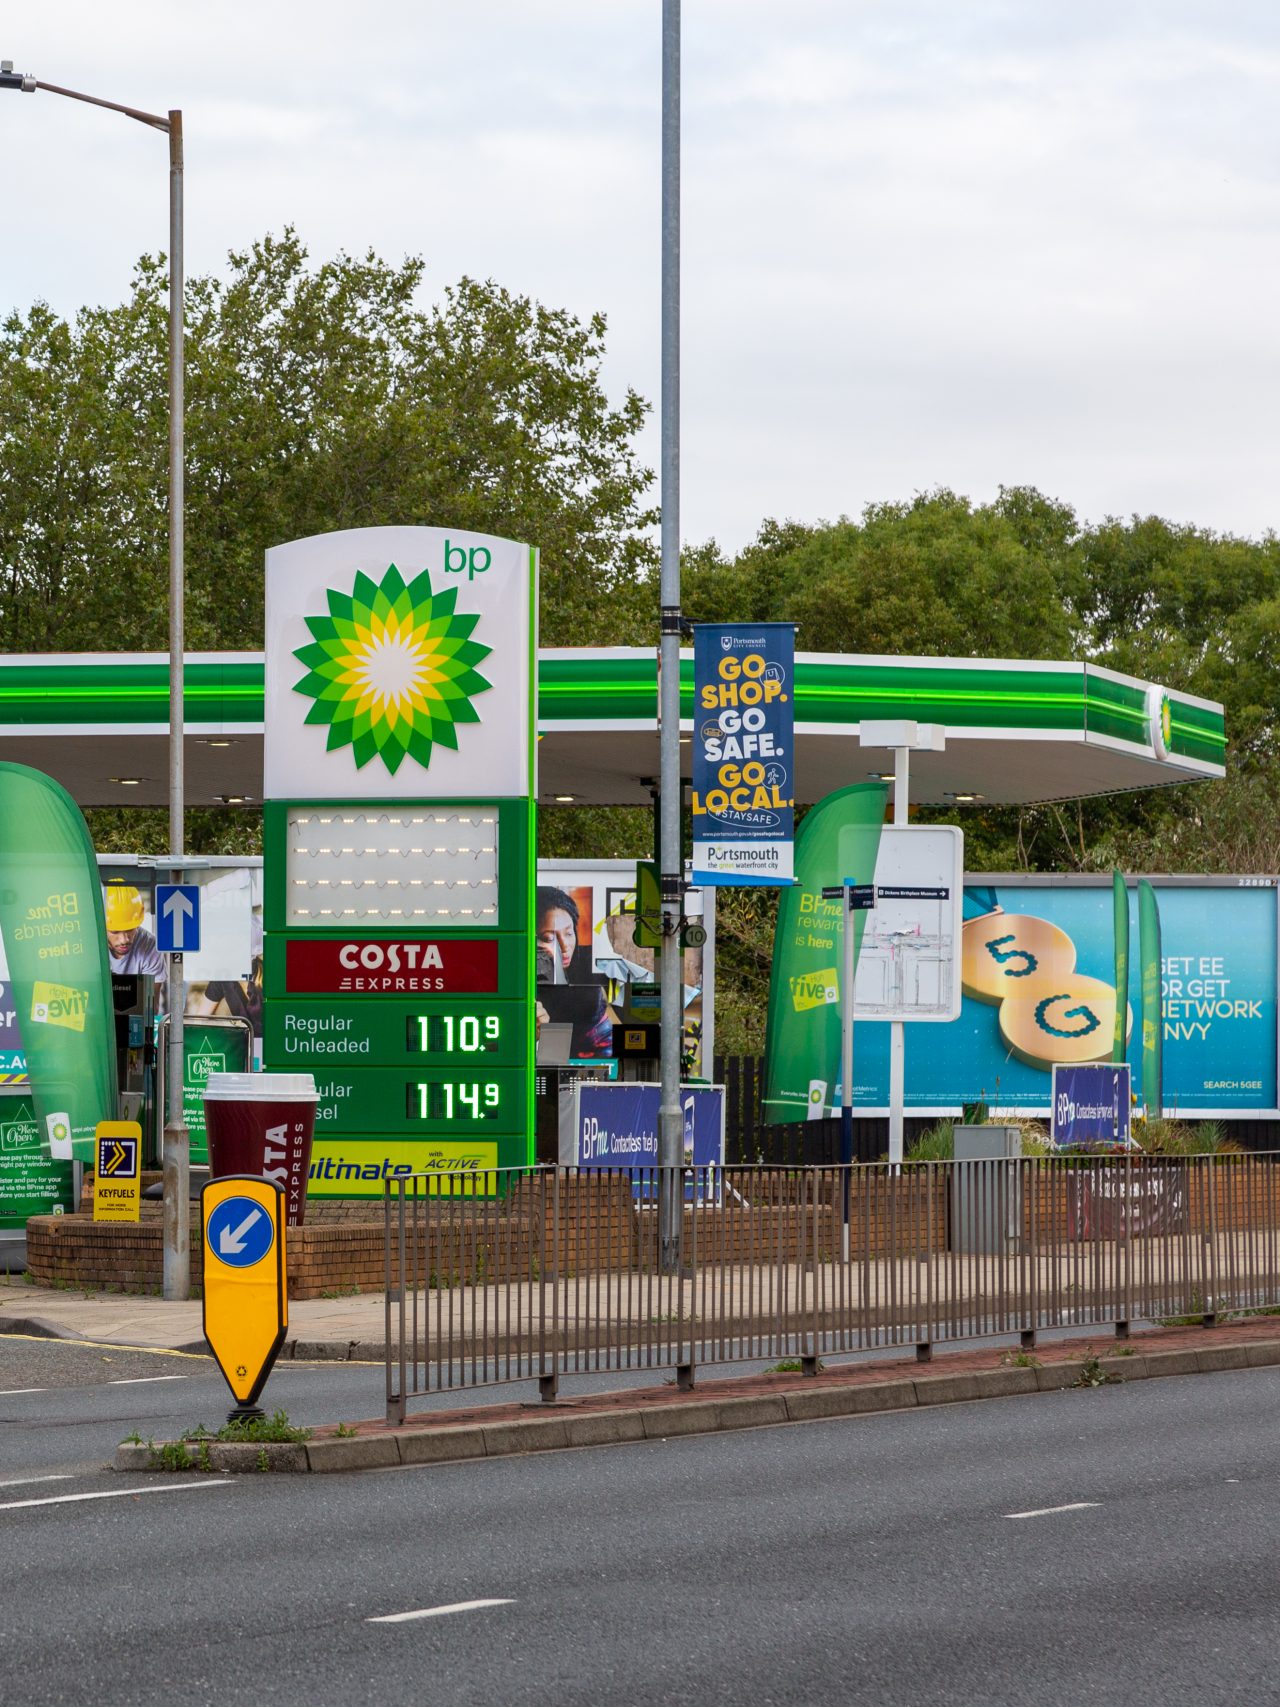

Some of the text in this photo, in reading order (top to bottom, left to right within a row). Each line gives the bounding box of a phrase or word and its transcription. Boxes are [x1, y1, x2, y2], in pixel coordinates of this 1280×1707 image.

[443, 540, 492, 580] bp
[733, 637, 767, 645] Portsmouth
[718, 654, 766, 681] GO
[701, 680, 788, 709] SHOP.
[718, 707, 766, 734] GO
[704, 733, 784, 762] SAFE.
[718, 761, 766, 788] GO
[692, 784, 795, 815] LOCAL.
[715, 810, 772, 824] #STAYSAFE
[707, 846, 779, 861] Portsmouth
[768, 862, 778, 870] city
[799, 893, 844, 917] BPme
[797, 916, 845, 932] reward
[687, 931, 704, 943] 10
[795, 933, 833, 949] is here
[174, 954, 181, 962] 2
[339, 944, 444, 973] COSTA
[1161, 957, 1224, 976] ET EE
[356, 977, 444, 990] EXPRESS
[985, 935, 1101, 1039] 5 G
[1187, 980, 1231, 998] GET
[1162, 1000, 1263, 1019] ETWORK
[285, 1015, 354, 1035] Regular
[1164, 1022, 1212, 1041] NVY
[285, 1038, 370, 1053] Unleaded
[193, 1059, 216, 1080] Open
[319, 1083, 353, 1097] ular
[1203, 1081, 1262, 1089] SEARCH 5GEE
[183, 1108, 197, 1116] gister
[315, 1104, 338, 1119] sel
[6, 1126, 35, 1147] Open
[583, 1117, 609, 1160] BPme
[610, 1132, 642, 1154] Contactless
[642, 1131, 653, 1153] fuel
[262, 1123, 289, 1183] STA
[289, 1123, 304, 1213] EXPRESS
[424, 1159, 481, 1169] ACTIVE
[98, 1188, 135, 1198] KEYFUELS
